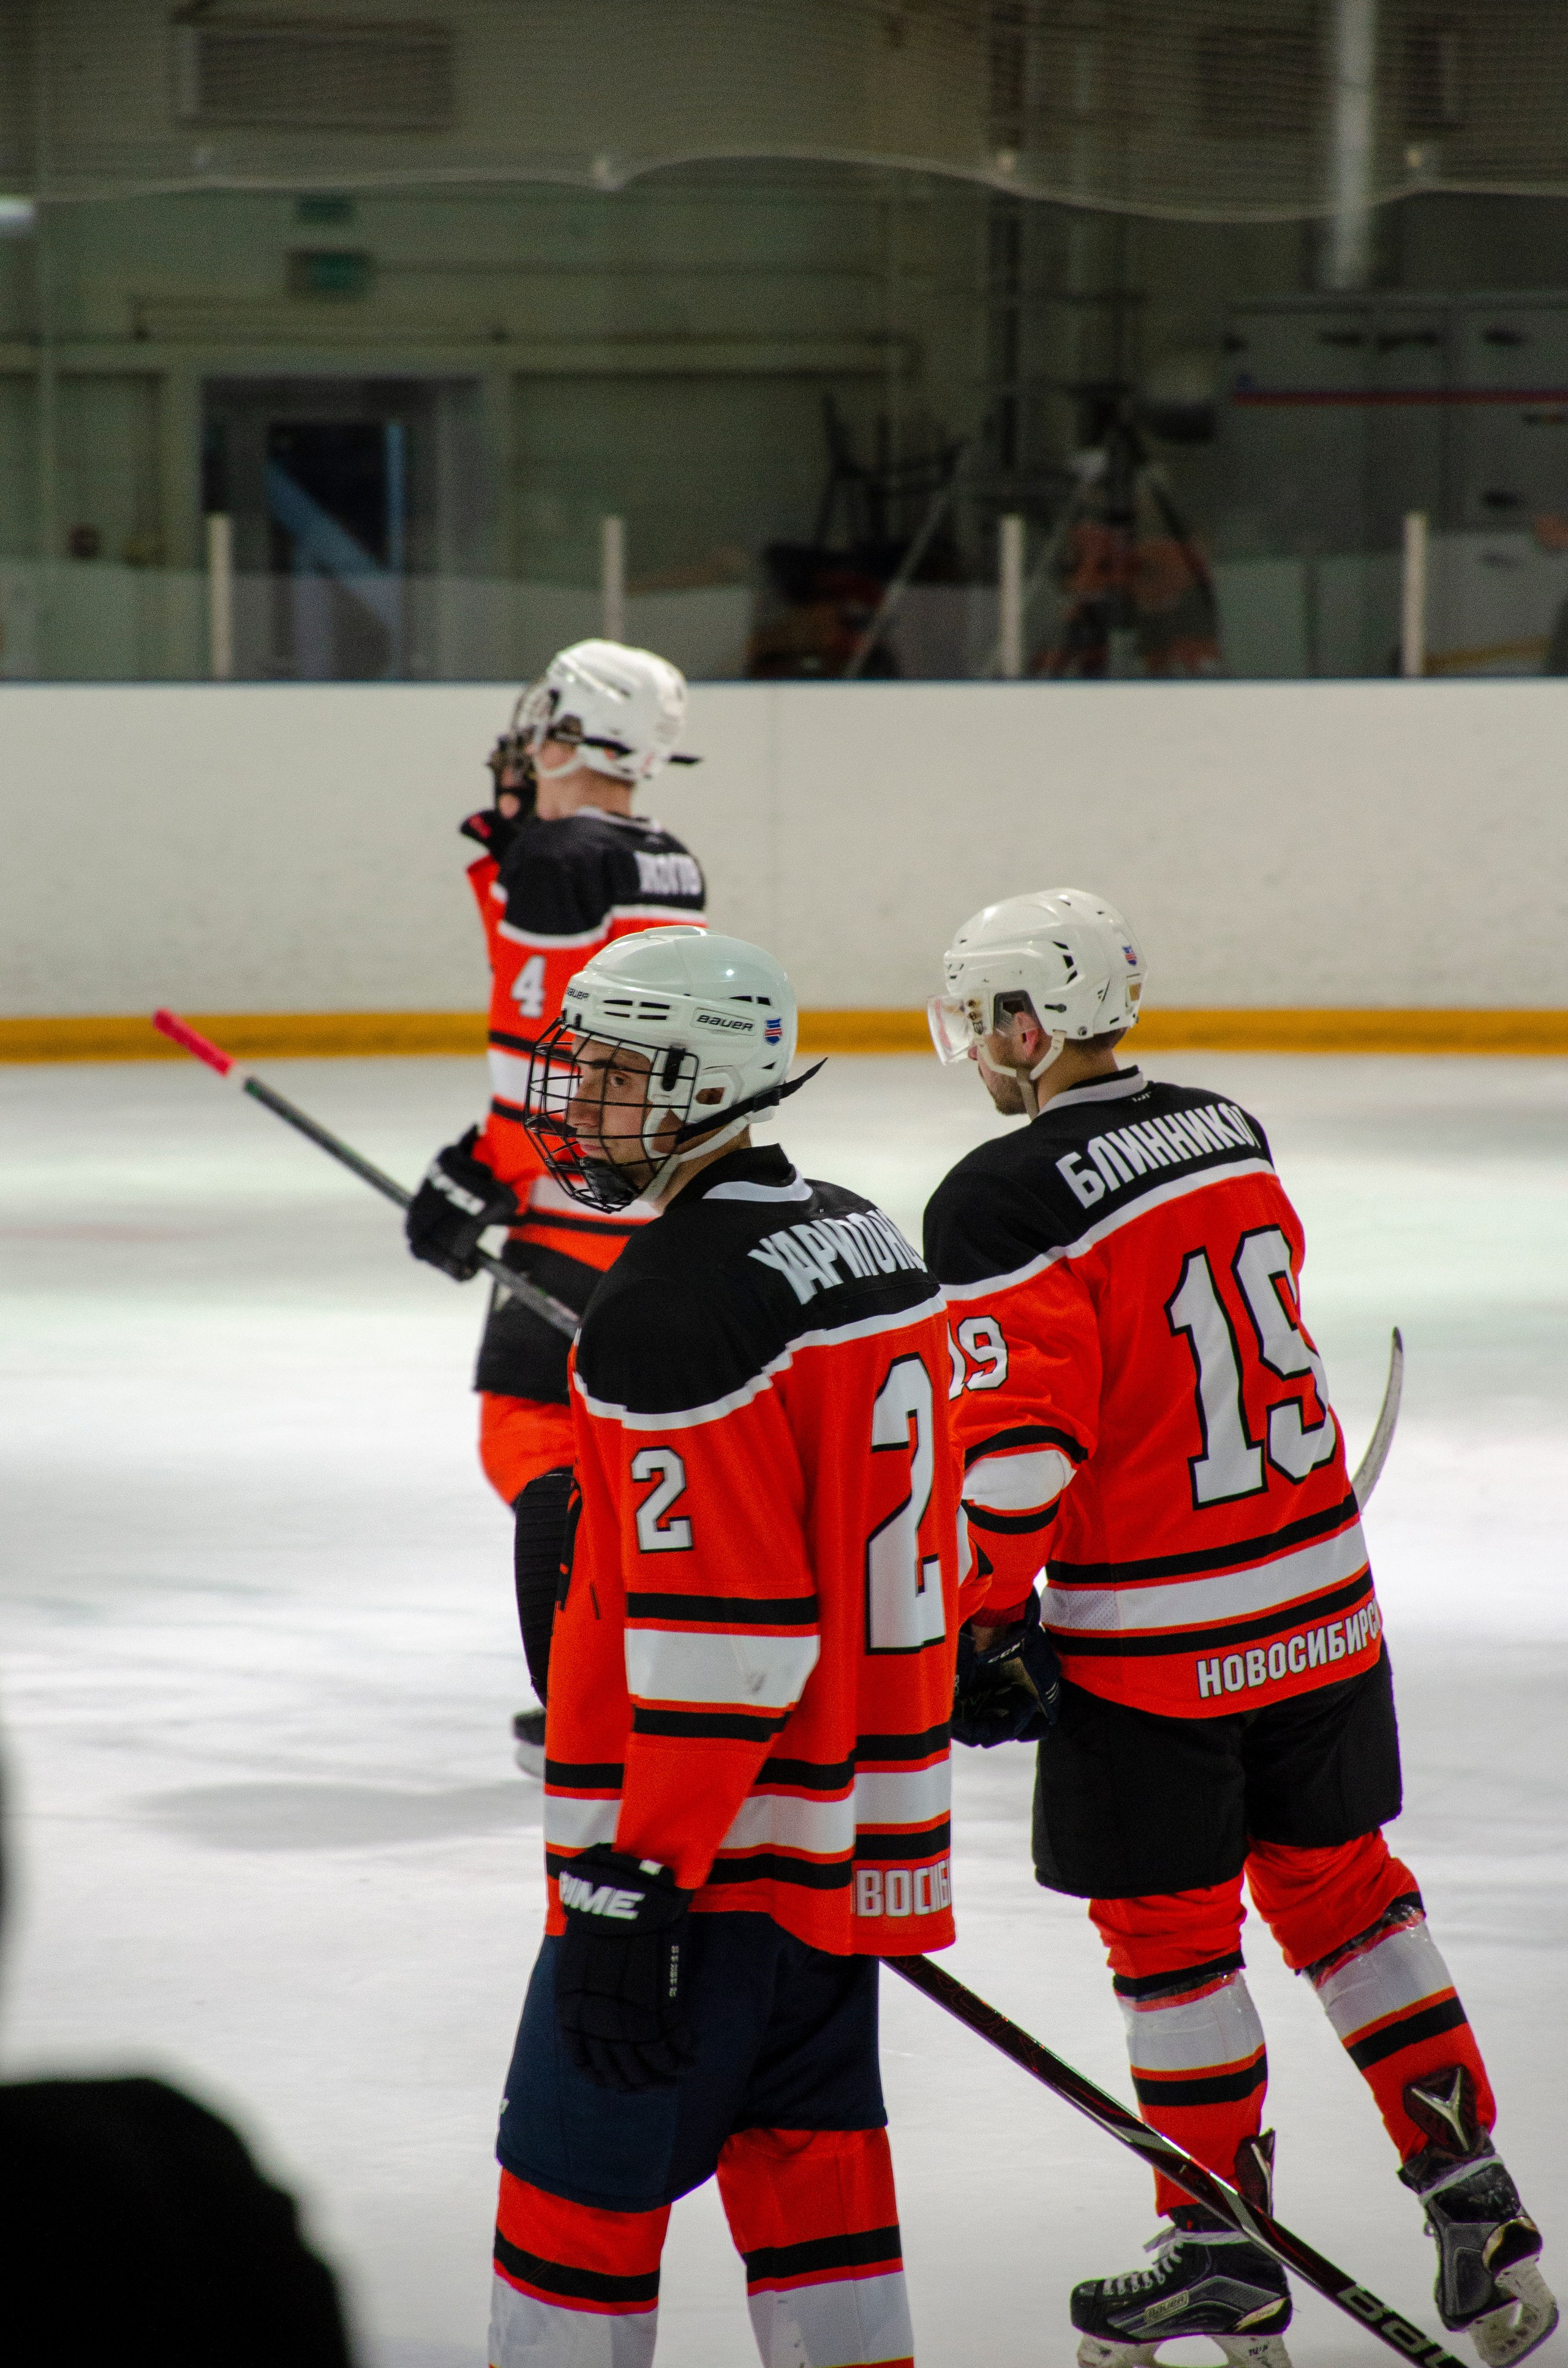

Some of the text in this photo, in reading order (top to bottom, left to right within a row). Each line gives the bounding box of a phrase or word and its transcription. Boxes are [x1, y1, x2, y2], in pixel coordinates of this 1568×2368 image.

[511, 955, 546, 1018] 4
[696, 1015, 754, 1032] BAUER
[1055, 1103, 1262, 1209] БЛИННИКО
[947, 1315, 1009, 1402] 19
[1164, 1224, 1337, 1511] 19
[631, 1445, 694, 1554] 2
[865, 1352, 946, 1655] 2
